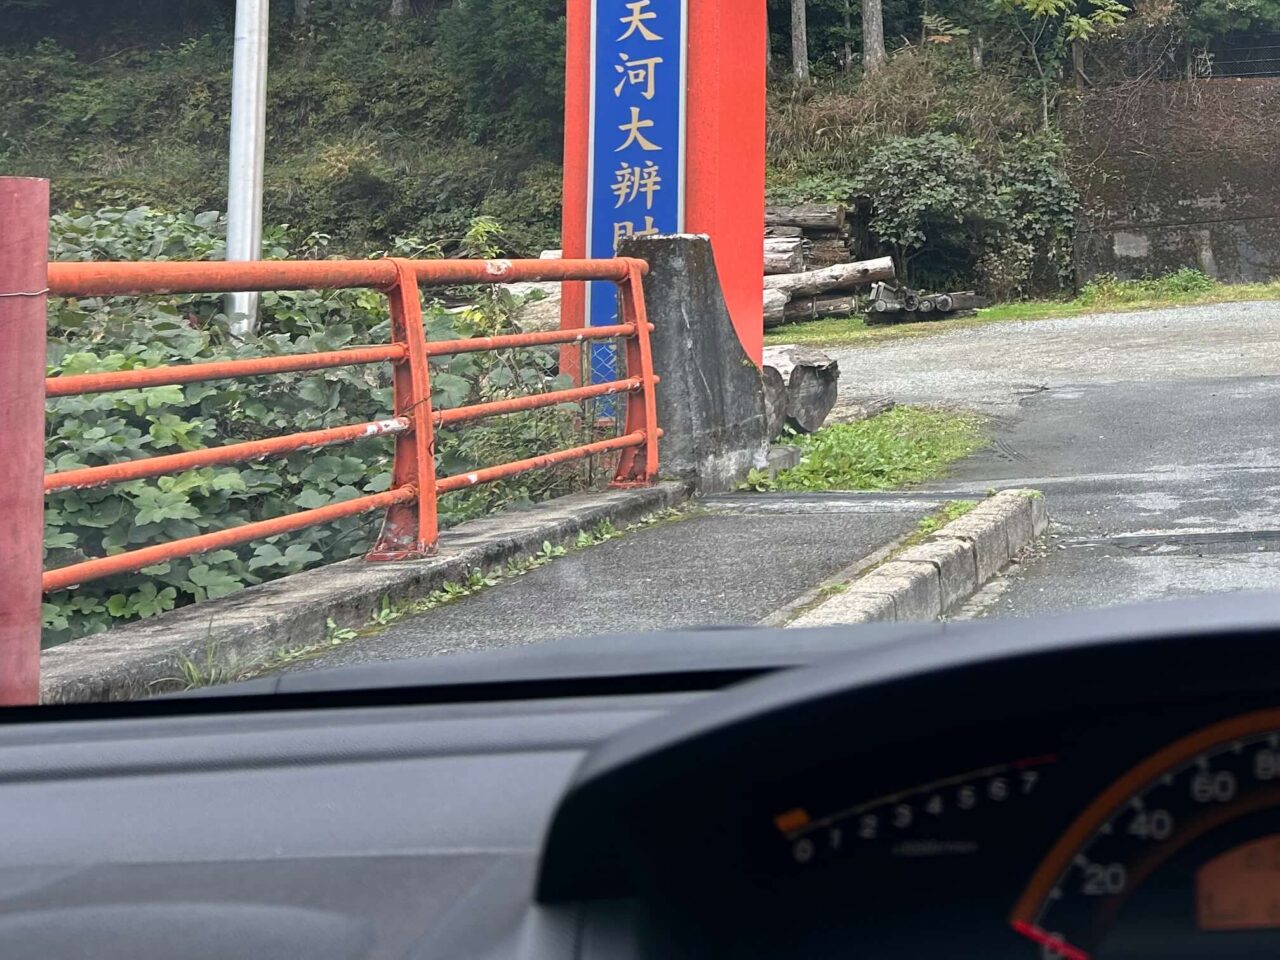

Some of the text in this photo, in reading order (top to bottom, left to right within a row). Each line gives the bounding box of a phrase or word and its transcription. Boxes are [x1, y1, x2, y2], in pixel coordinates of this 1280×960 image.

[793, 837, 815, 864] 0
[858, 814, 879, 839] 2
[893, 803, 913, 829] 3
[925, 794, 944, 815] 4
[957, 784, 976, 810] 5
[988, 776, 1009, 802] 6
[1021, 770, 1039, 795] 7
[1081, 863, 1127, 895] 20
[1128, 809, 1172, 840] 40
[1191, 771, 1237, 802] 60
